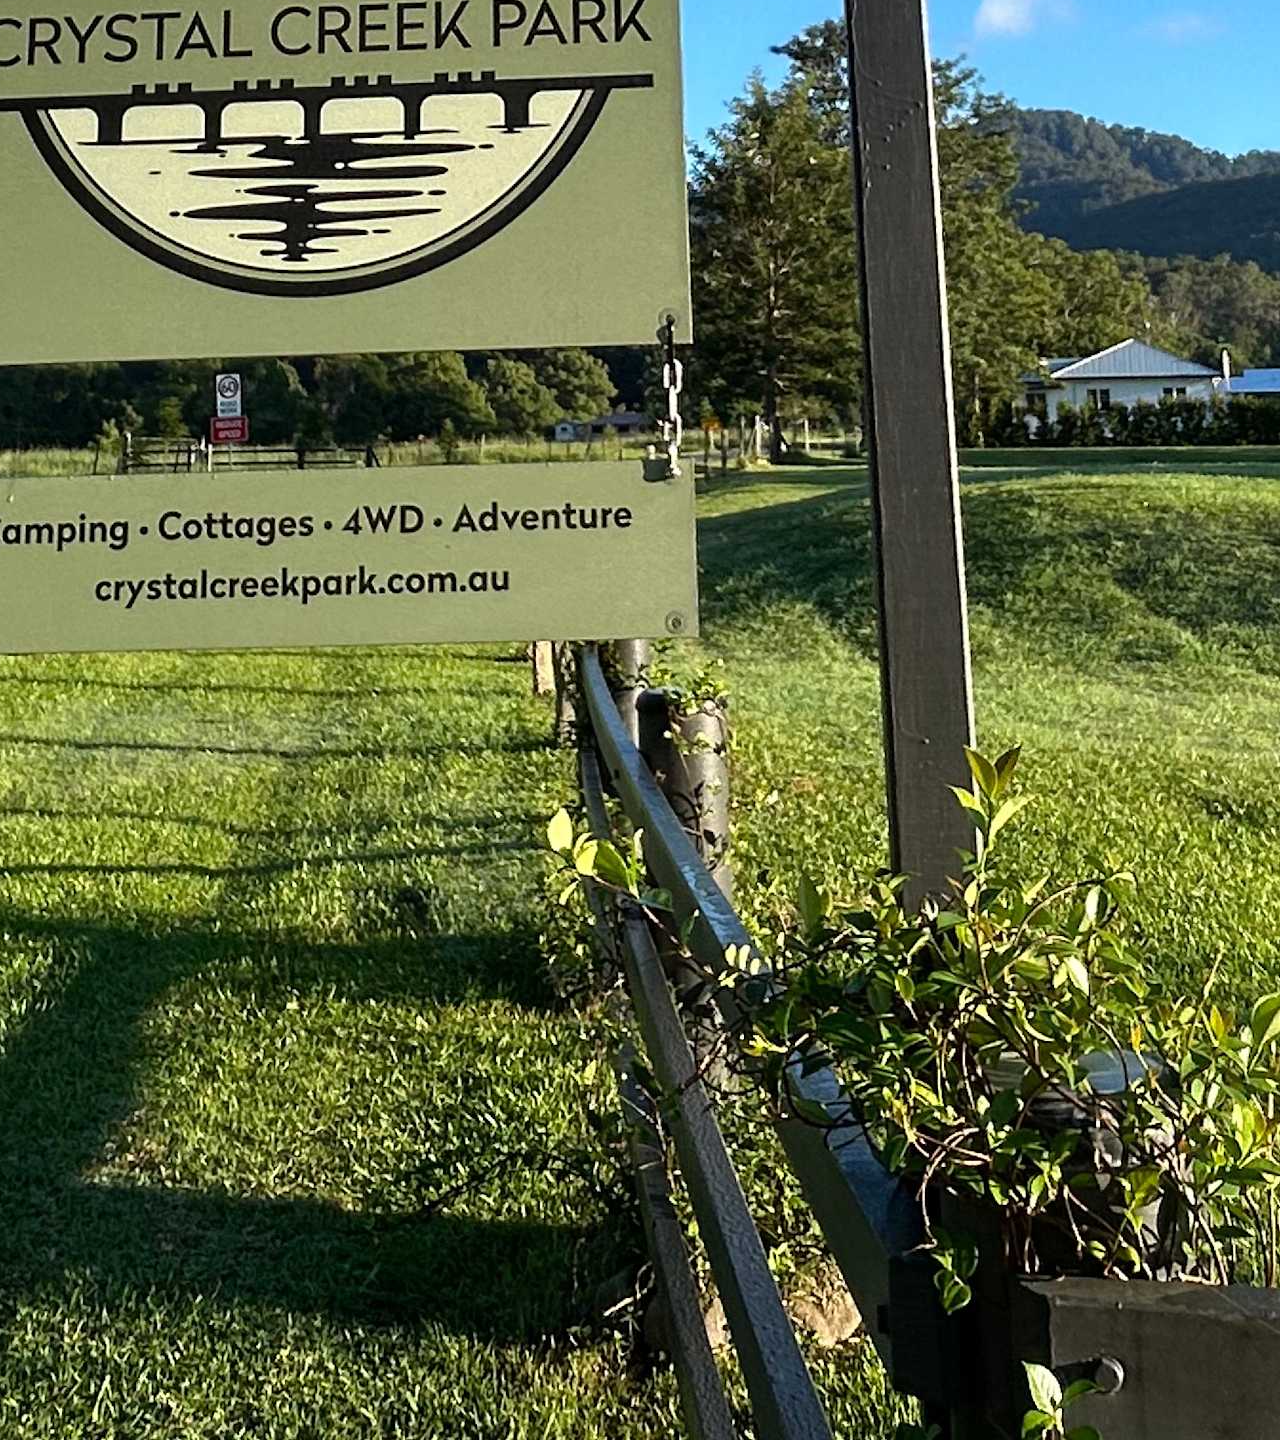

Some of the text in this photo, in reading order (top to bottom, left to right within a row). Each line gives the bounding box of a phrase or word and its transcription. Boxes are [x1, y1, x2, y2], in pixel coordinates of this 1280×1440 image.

[270, 0, 472, 56] CREEK
[158, 511, 314, 547] Cottages
[341, 505, 424, 536] 4WD
[451, 501, 633, 533] Adventure
[95, 565, 510, 610] crystalcreekpark.com.au
